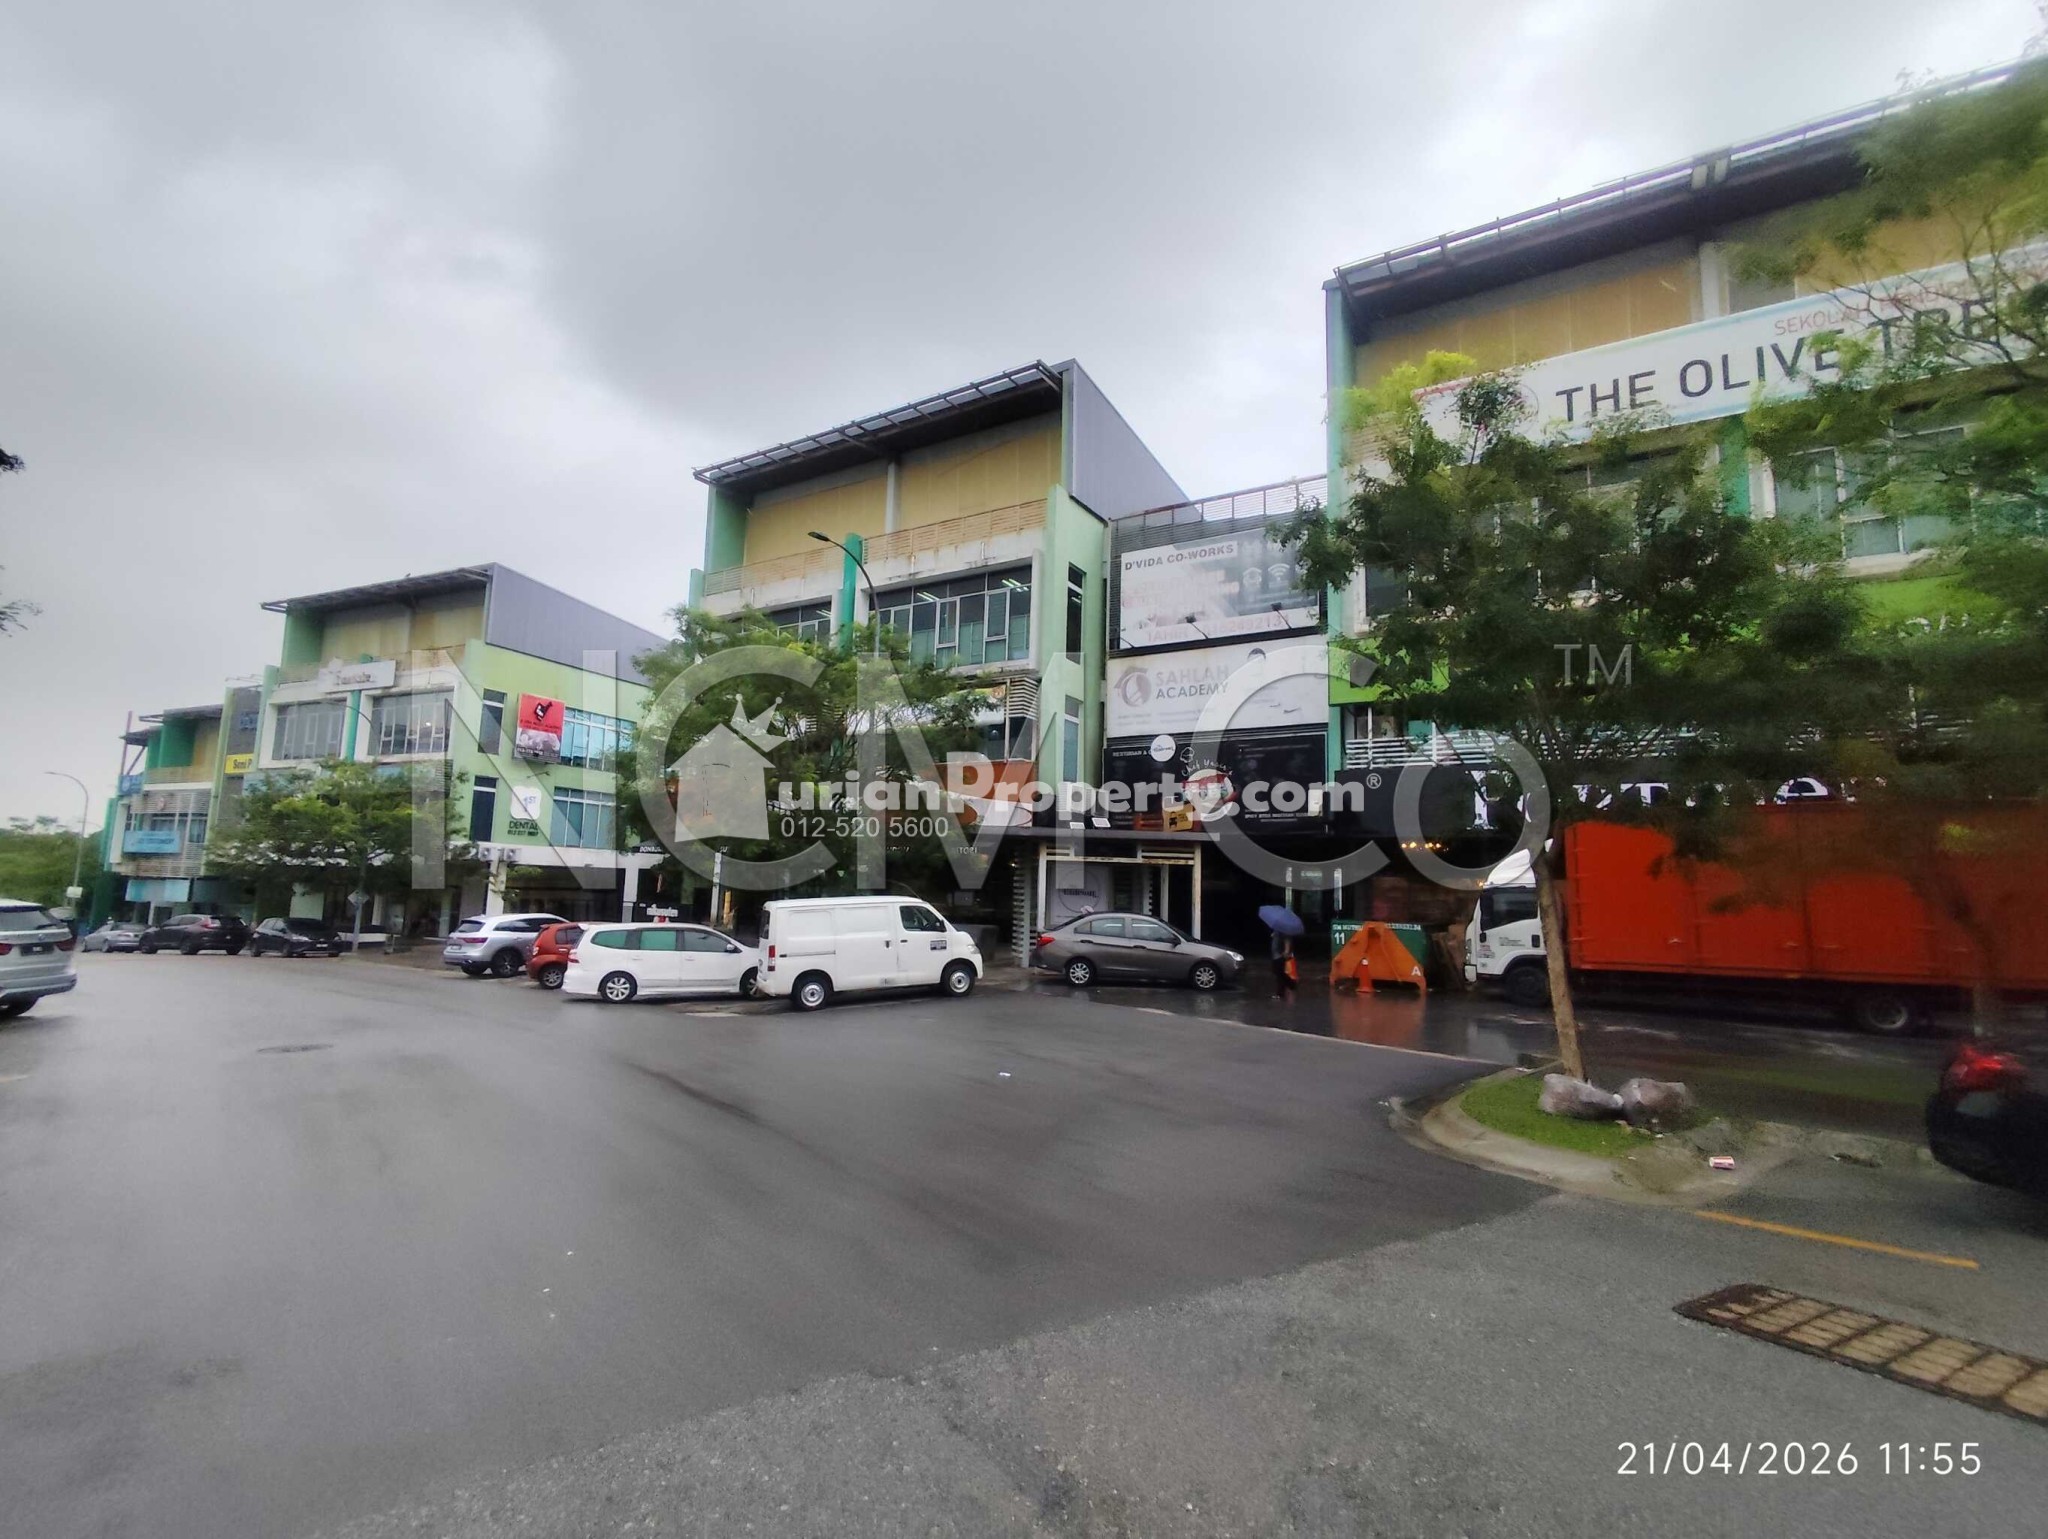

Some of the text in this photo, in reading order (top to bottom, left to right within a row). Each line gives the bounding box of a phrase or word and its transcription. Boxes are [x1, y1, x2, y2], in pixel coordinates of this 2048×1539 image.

[1556, 369, 1657, 421] THE
[1679, 328, 1845, 398] OLIVE
[1125, 544, 1234, 571] D'VIDA CO-WORKS
[1156, 665, 1230, 686] SAHLAH
[1156, 682, 1229, 700] ACADEMY
[509, 820, 538, 831] DENTAL
[1334, 932, 1345, 945] 11
[1411, 965, 1421, 977] A
